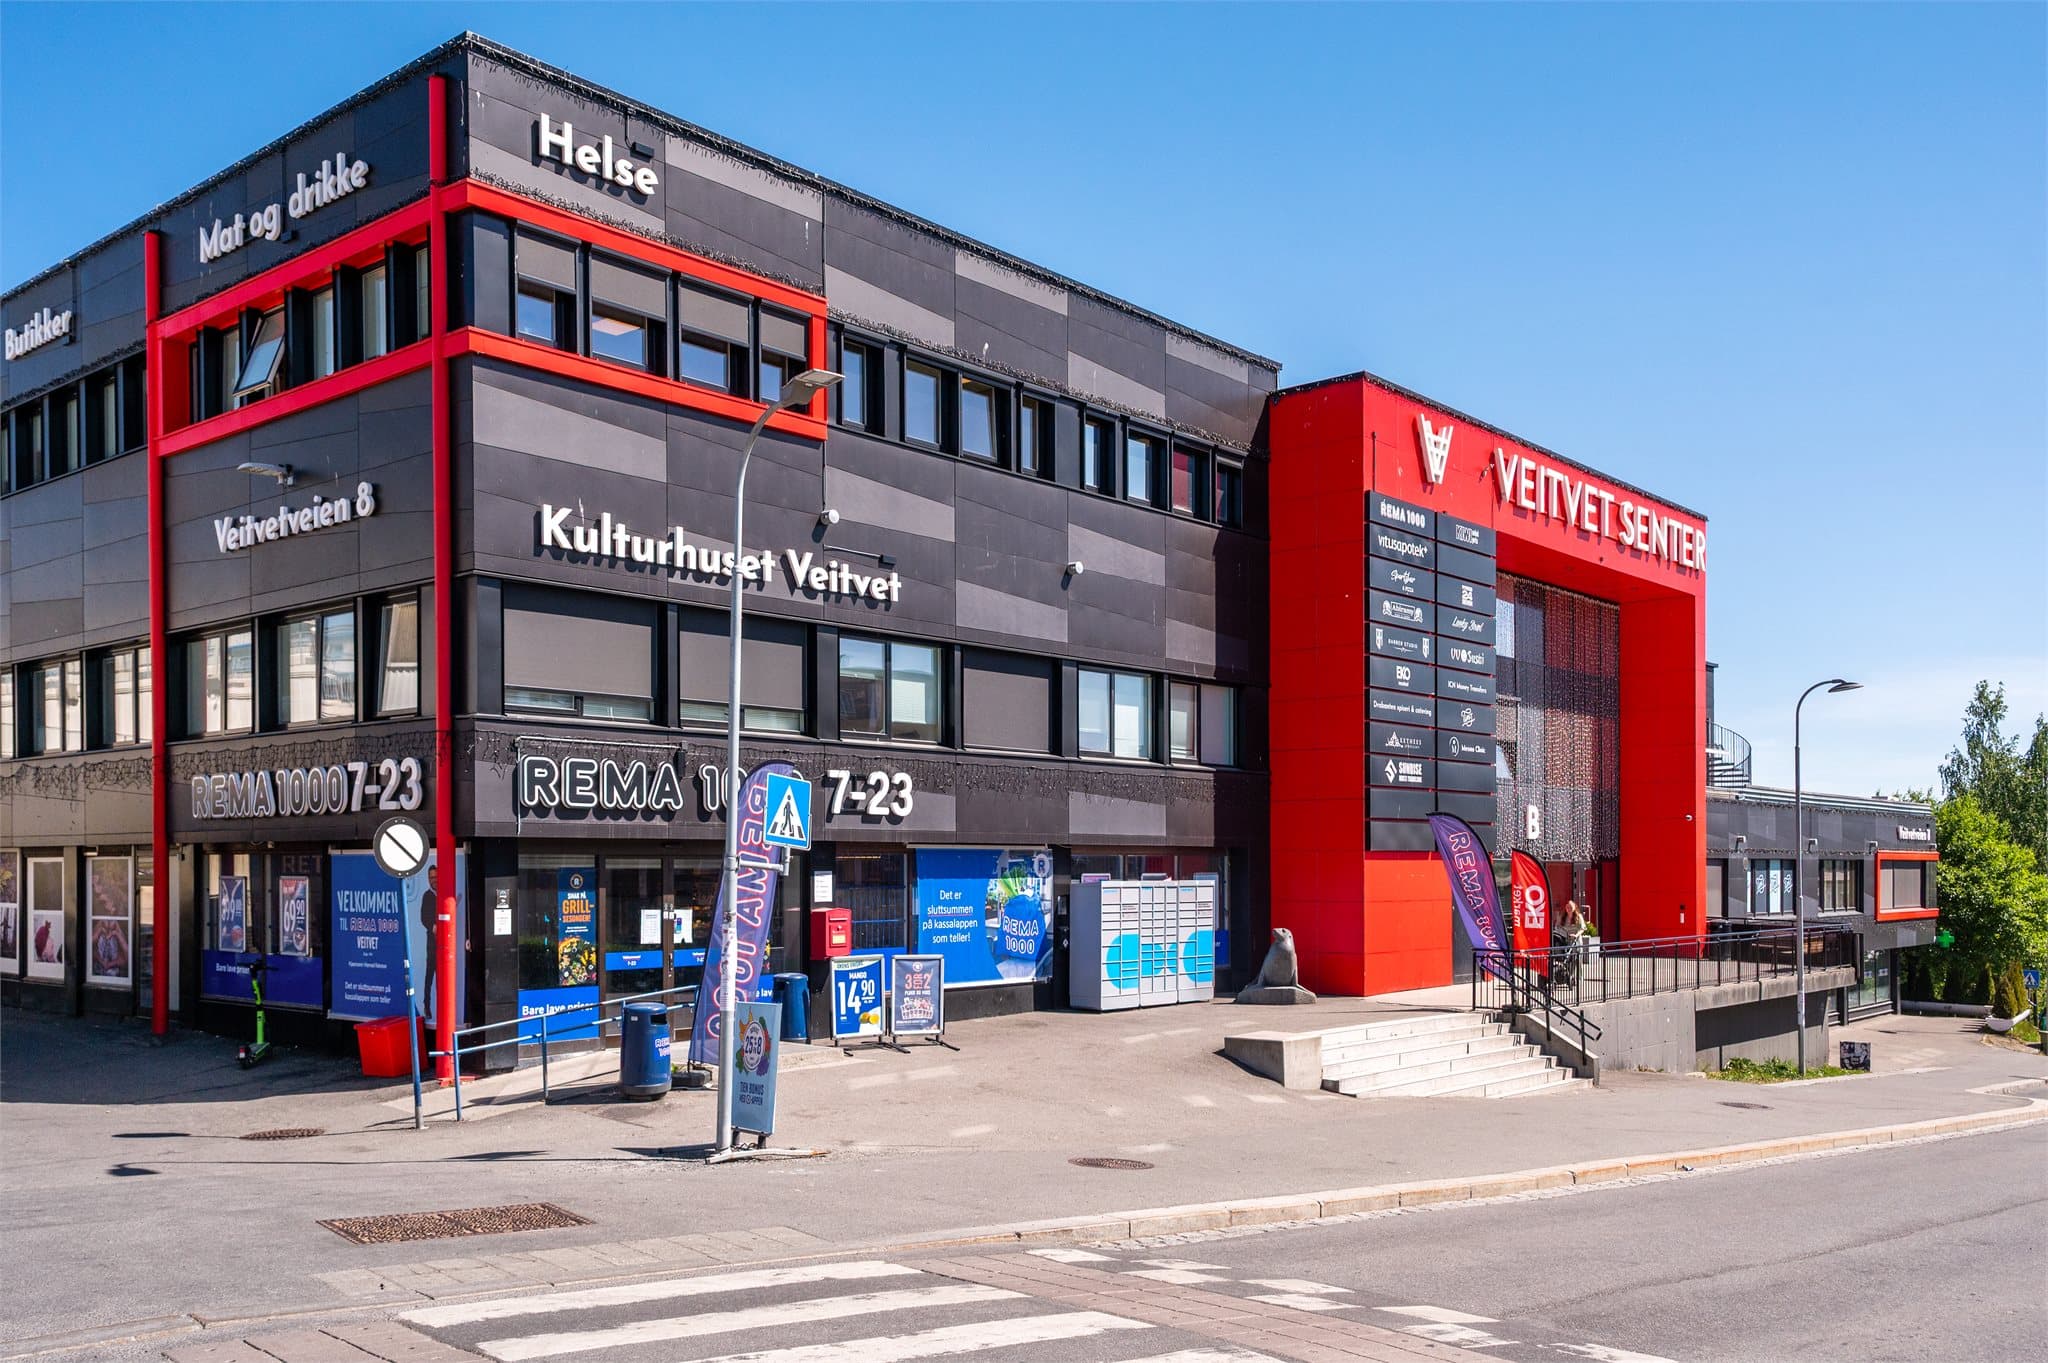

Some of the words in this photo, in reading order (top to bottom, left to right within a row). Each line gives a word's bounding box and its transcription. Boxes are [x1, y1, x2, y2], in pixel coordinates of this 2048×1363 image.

[539, 112, 659, 195] Helse
[200, 213, 246, 264] Mat
[250, 204, 281, 241] og
[288, 151, 370, 219] drikke
[4, 307, 72, 361] Butikker
[215, 494, 352, 553] Veitvetveien
[356, 481, 376, 517] 8
[1380, 501, 1406, 522] REMA
[1406, 510, 1426, 528] 1000
[1494, 447, 1616, 537] VEITVET
[1617, 501, 1706, 572] SENTER
[540, 503, 776, 582] Kulturhuset
[785, 549, 902, 601] Veitvet
[1396, 665, 1411, 681] EKO
[191, 769, 276, 818] REMA
[276, 764, 348, 815] 1000
[348, 757, 423, 812] 7-23
[520, 754, 684, 811] REMA
[827, 769, 914, 817] 7-23
[1527, 804, 1540, 840] B
[1449, 831, 1485, 910] REMA
[337, 890, 399, 913] VELKOMMEN
[562, 899, 595, 914] GRILL-
[939, 889, 953, 900] Det
[954, 892, 962, 900] er
[284, 900, 296, 932] 69
[296, 900, 305, 916] 90
[927, 904, 974, 915] sluttsummen
[340, 918, 348, 931] TIL
[350, 917, 377, 932] REMA
[378, 918, 399, 932] 1000
[922, 921, 933, 931] på
[934, 919, 978, 930] kassalappen
[1003, 916, 1039, 937] REMA
[357, 936, 379, 949] VEITVET
[932, 935, 947, 944] som
[949, 933, 971, 943] teller!
[1005, 936, 1035, 955] 1000
[905, 974, 913, 990] 3
[923, 974, 932, 990] 2
[838, 981, 862, 1015] 14
[861, 979, 875, 996] 90
[522, 1005, 545, 1016] Bare
